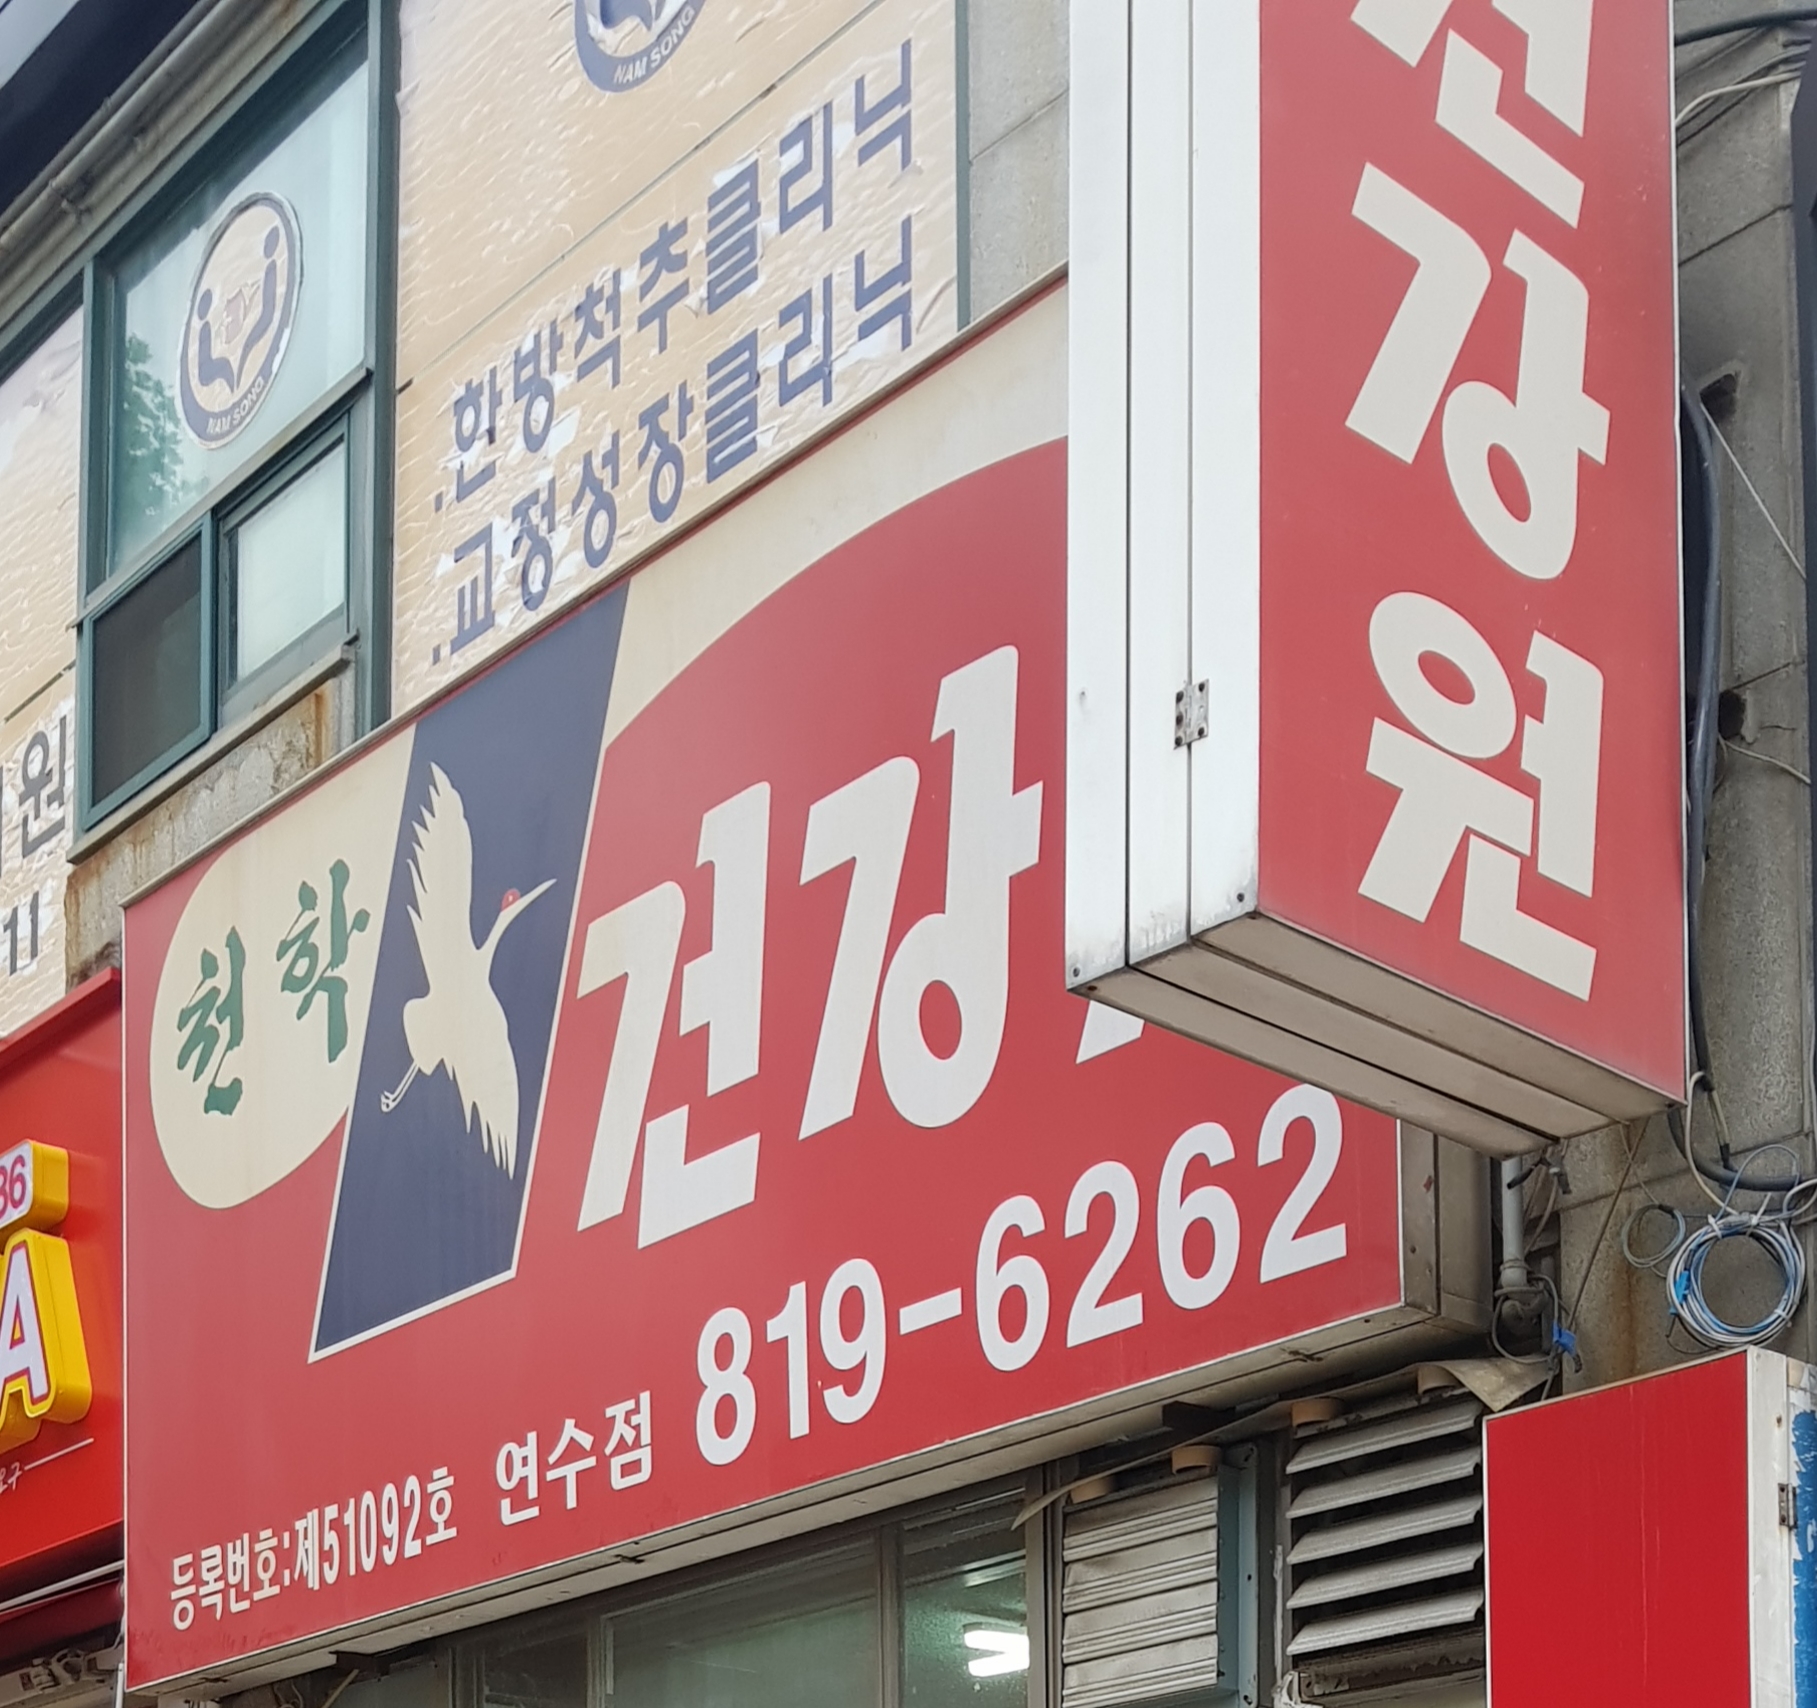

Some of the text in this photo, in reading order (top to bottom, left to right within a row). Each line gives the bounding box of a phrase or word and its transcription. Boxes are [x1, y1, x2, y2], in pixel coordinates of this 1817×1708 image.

[613, 6, 696, 84] NAM SONG
[206, 376, 265, 435] NAM SONG
[577, 643, 1145, 1250] 건강
[170, 1083, 1347, 1632] 등록번호:제51092호 연수점 819-6262
